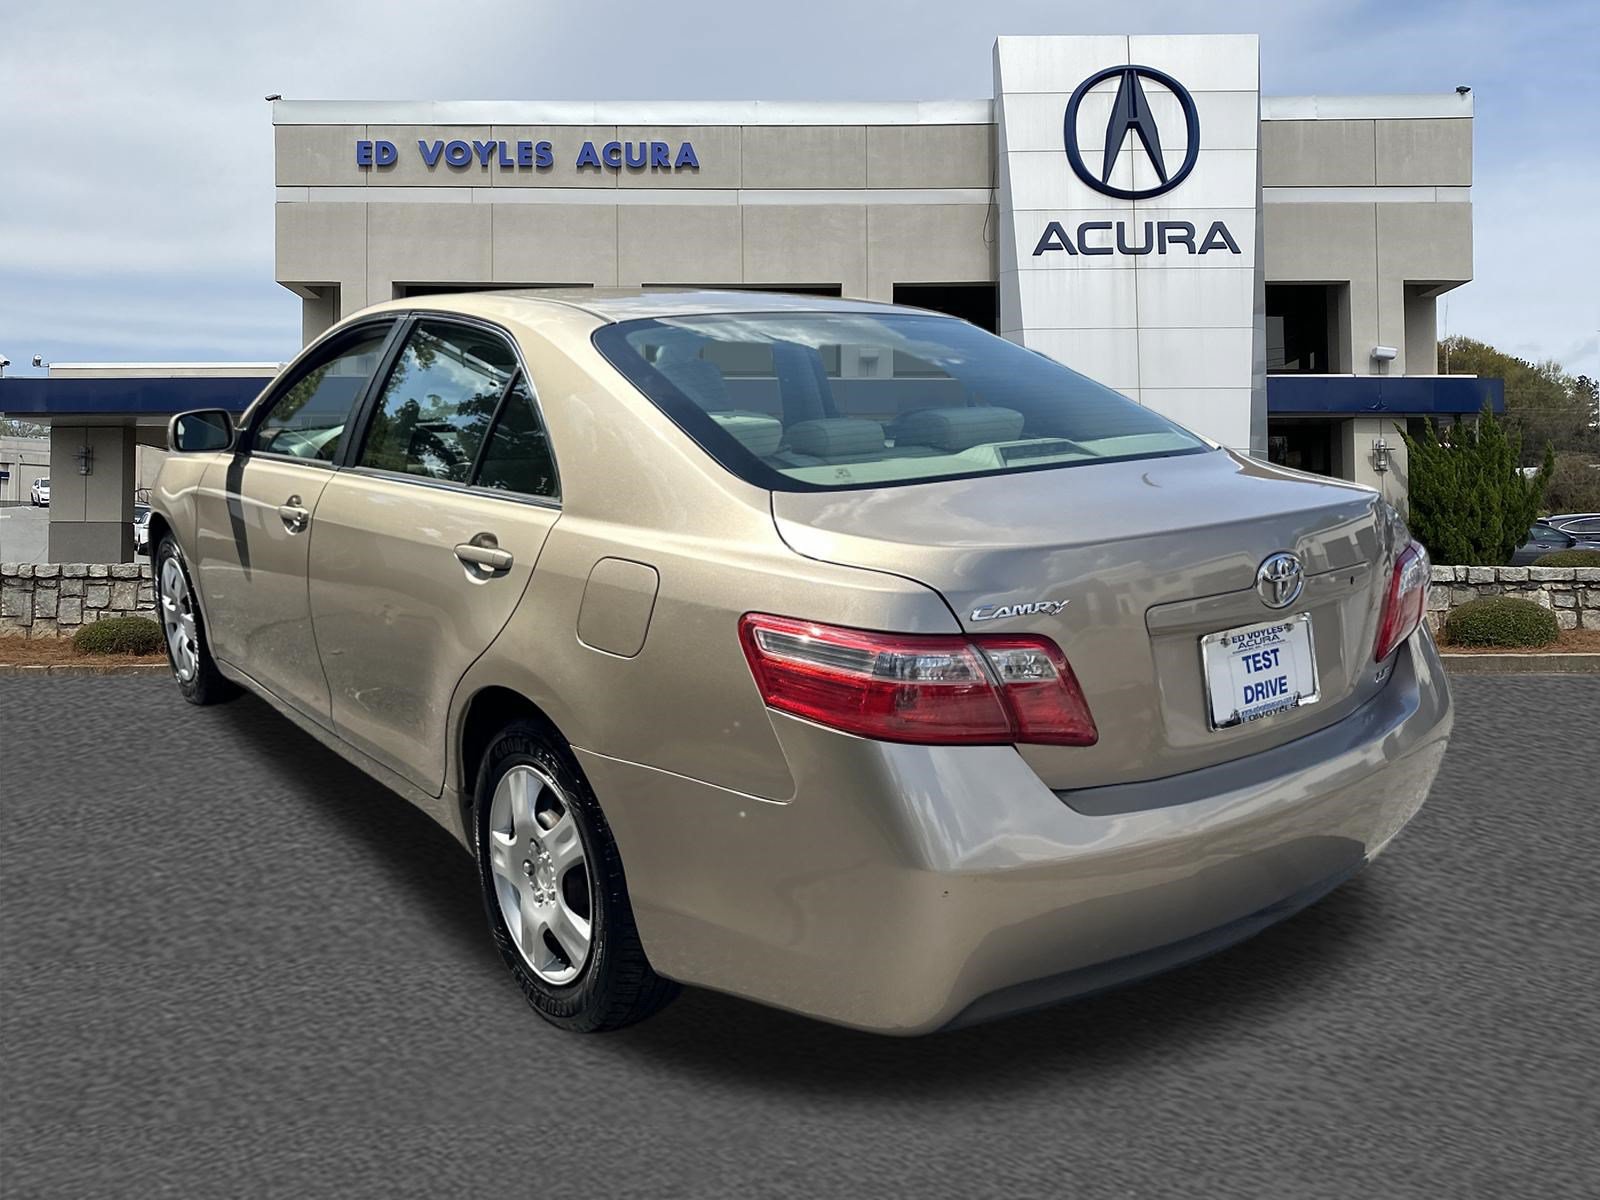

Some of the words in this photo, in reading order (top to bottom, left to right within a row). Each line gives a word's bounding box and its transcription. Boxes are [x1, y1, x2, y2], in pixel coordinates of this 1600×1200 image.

[356, 140, 398, 168] ED
[418, 140, 554, 168] VOYLES
[576, 141, 700, 169] ACURA
[1032, 221, 1242, 256] ACURA
[970, 599, 1071, 622] CAMRY
[1231, 634, 1245, 644] ED
[1247, 624, 1284, 640] VOYLES
[1238, 633, 1280, 650] ACURA
[1241, 647, 1280, 674] TEST
[1243, 675, 1289, 705] DRIVE
